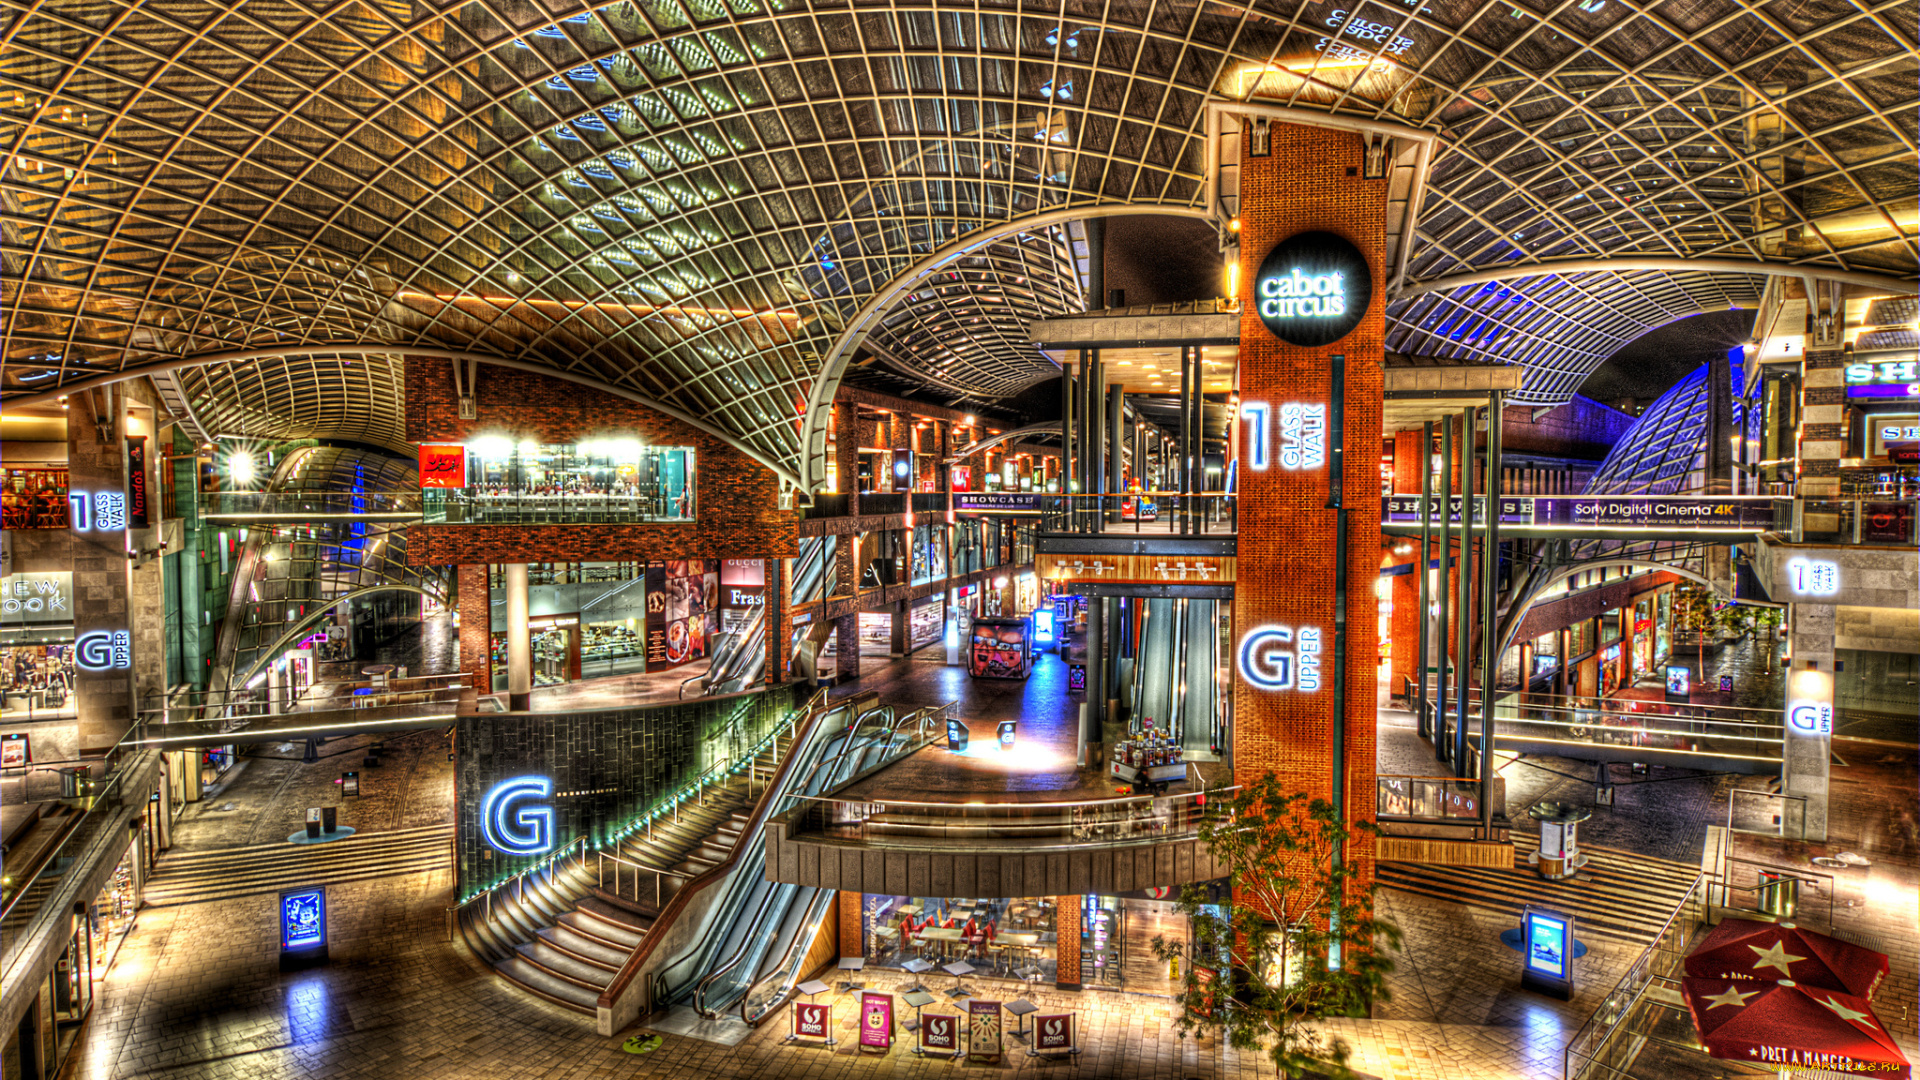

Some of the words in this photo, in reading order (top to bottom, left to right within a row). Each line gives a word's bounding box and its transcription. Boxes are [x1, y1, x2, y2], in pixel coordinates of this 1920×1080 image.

[1261, 267, 1345, 298] cabot
[1261, 295, 1345, 317] circus
[1242, 405, 1268, 469] 1
[1283, 406, 1301, 467] GLASS
[1304, 406, 1323, 467] WALK
[131, 470, 145, 517] Nando's
[962, 496, 1033, 504] SHOWCASE
[1575, 503, 1608, 516] Sony
[1609, 503, 1653, 517] Digital
[1714, 504, 1735, 516] 4K
[69, 493, 88, 530] 1
[96, 494, 109, 529] GLASS
[110, 494, 124, 529] WALK
[728, 559, 762, 567] GUCCI
[1791, 562, 1806, 592] 1
[76, 633, 112, 669] G
[114, 632, 129, 668] UPPER
[1239, 626, 1293, 689] G
[1300, 629, 1318, 690] UPPER
[1791, 705, 1817, 731] G
[1820, 705, 1831, 733] UPPER
[483, 776, 552, 854] G
[802, 1022, 822, 1031] SOHO
[929, 1034, 950, 1043] SOHO
[1043, 1034, 1064, 1043] SOHO
[1760, 1045, 1788, 1062] PRET
[1791, 1049, 1800, 1064] A
